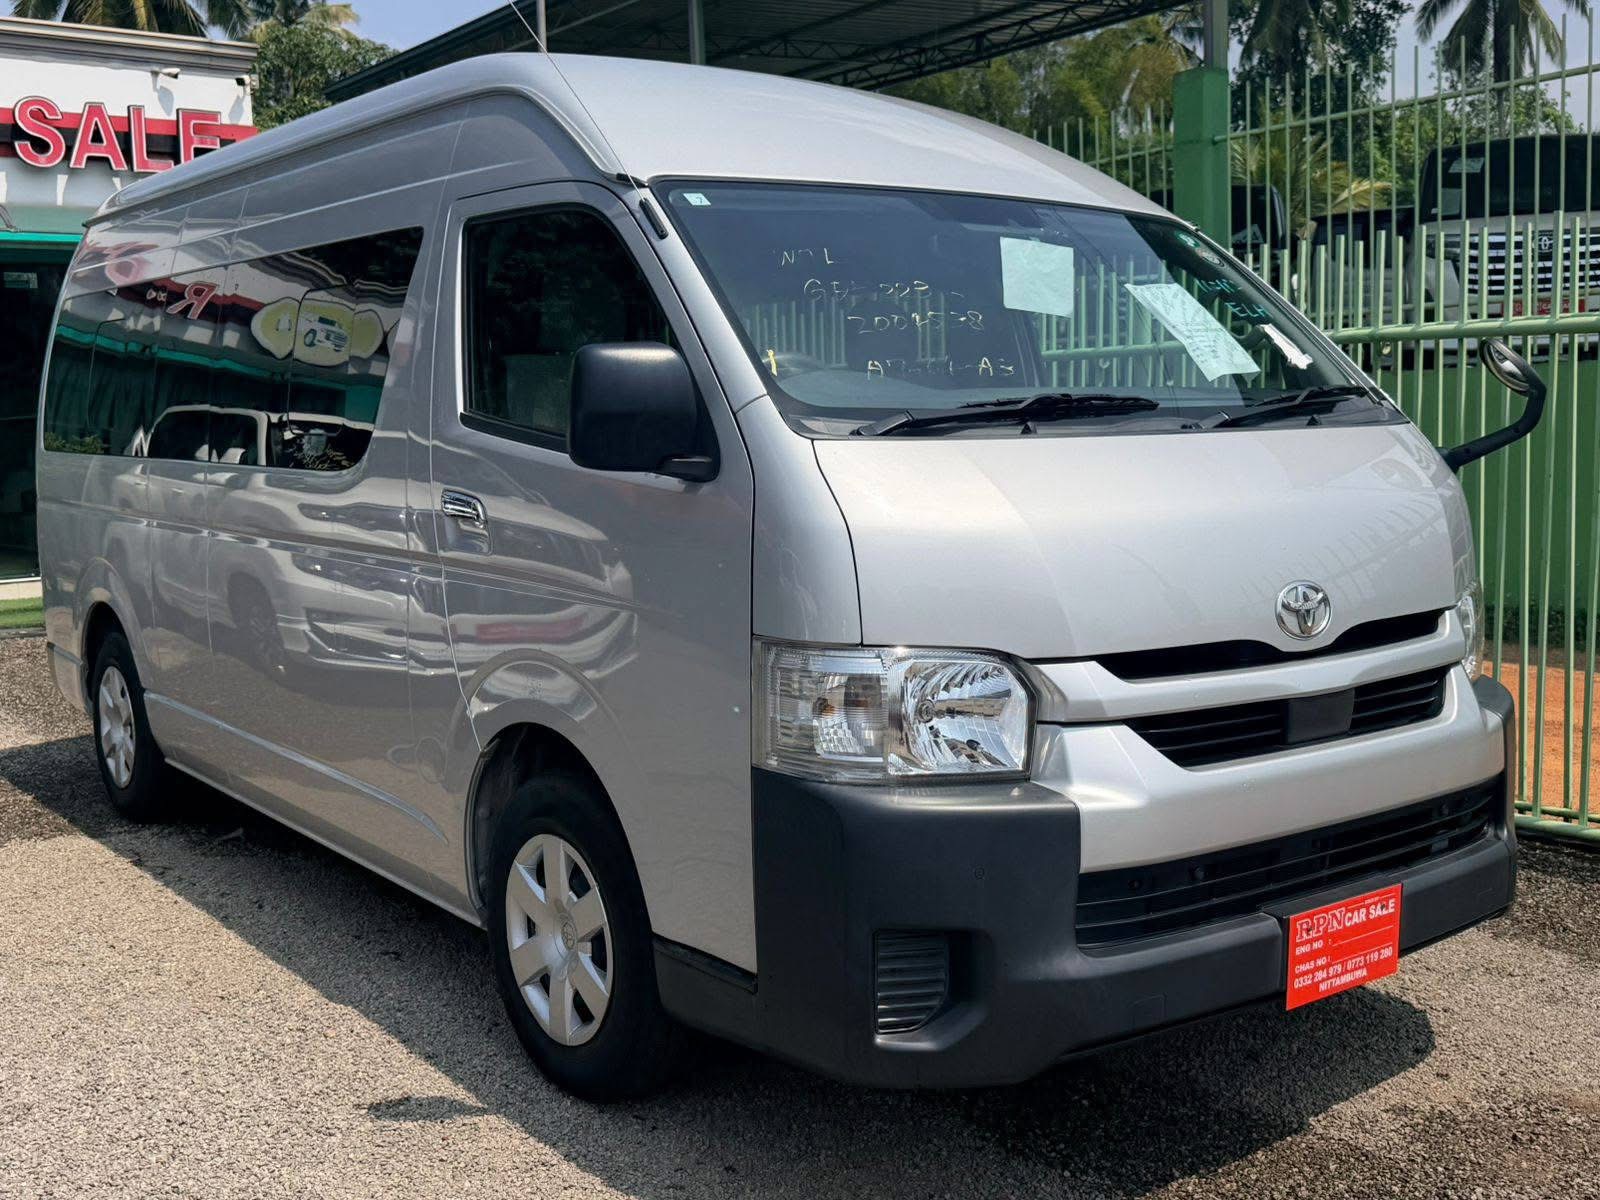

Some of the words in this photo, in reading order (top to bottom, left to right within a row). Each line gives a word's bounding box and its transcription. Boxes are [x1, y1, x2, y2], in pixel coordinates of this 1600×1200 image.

[14, 96, 221, 172] SALE
[1296, 907, 1345, 942] RPN
[1345, 909, 1367, 927] CAR
[1369, 898, 1396, 919] SALE
[1294, 974, 1313, 989] 0332
[1328, 963, 1342, 977] 979
[1347, 955, 1365, 970] 0773
[1366, 951, 1379, 964] 119
[1380, 946, 1393, 959] 280
[1295, 960, 1315, 974] CHAS
[1296, 943, 1311, 955] ENG
[1312, 939, 1323, 950] NO
